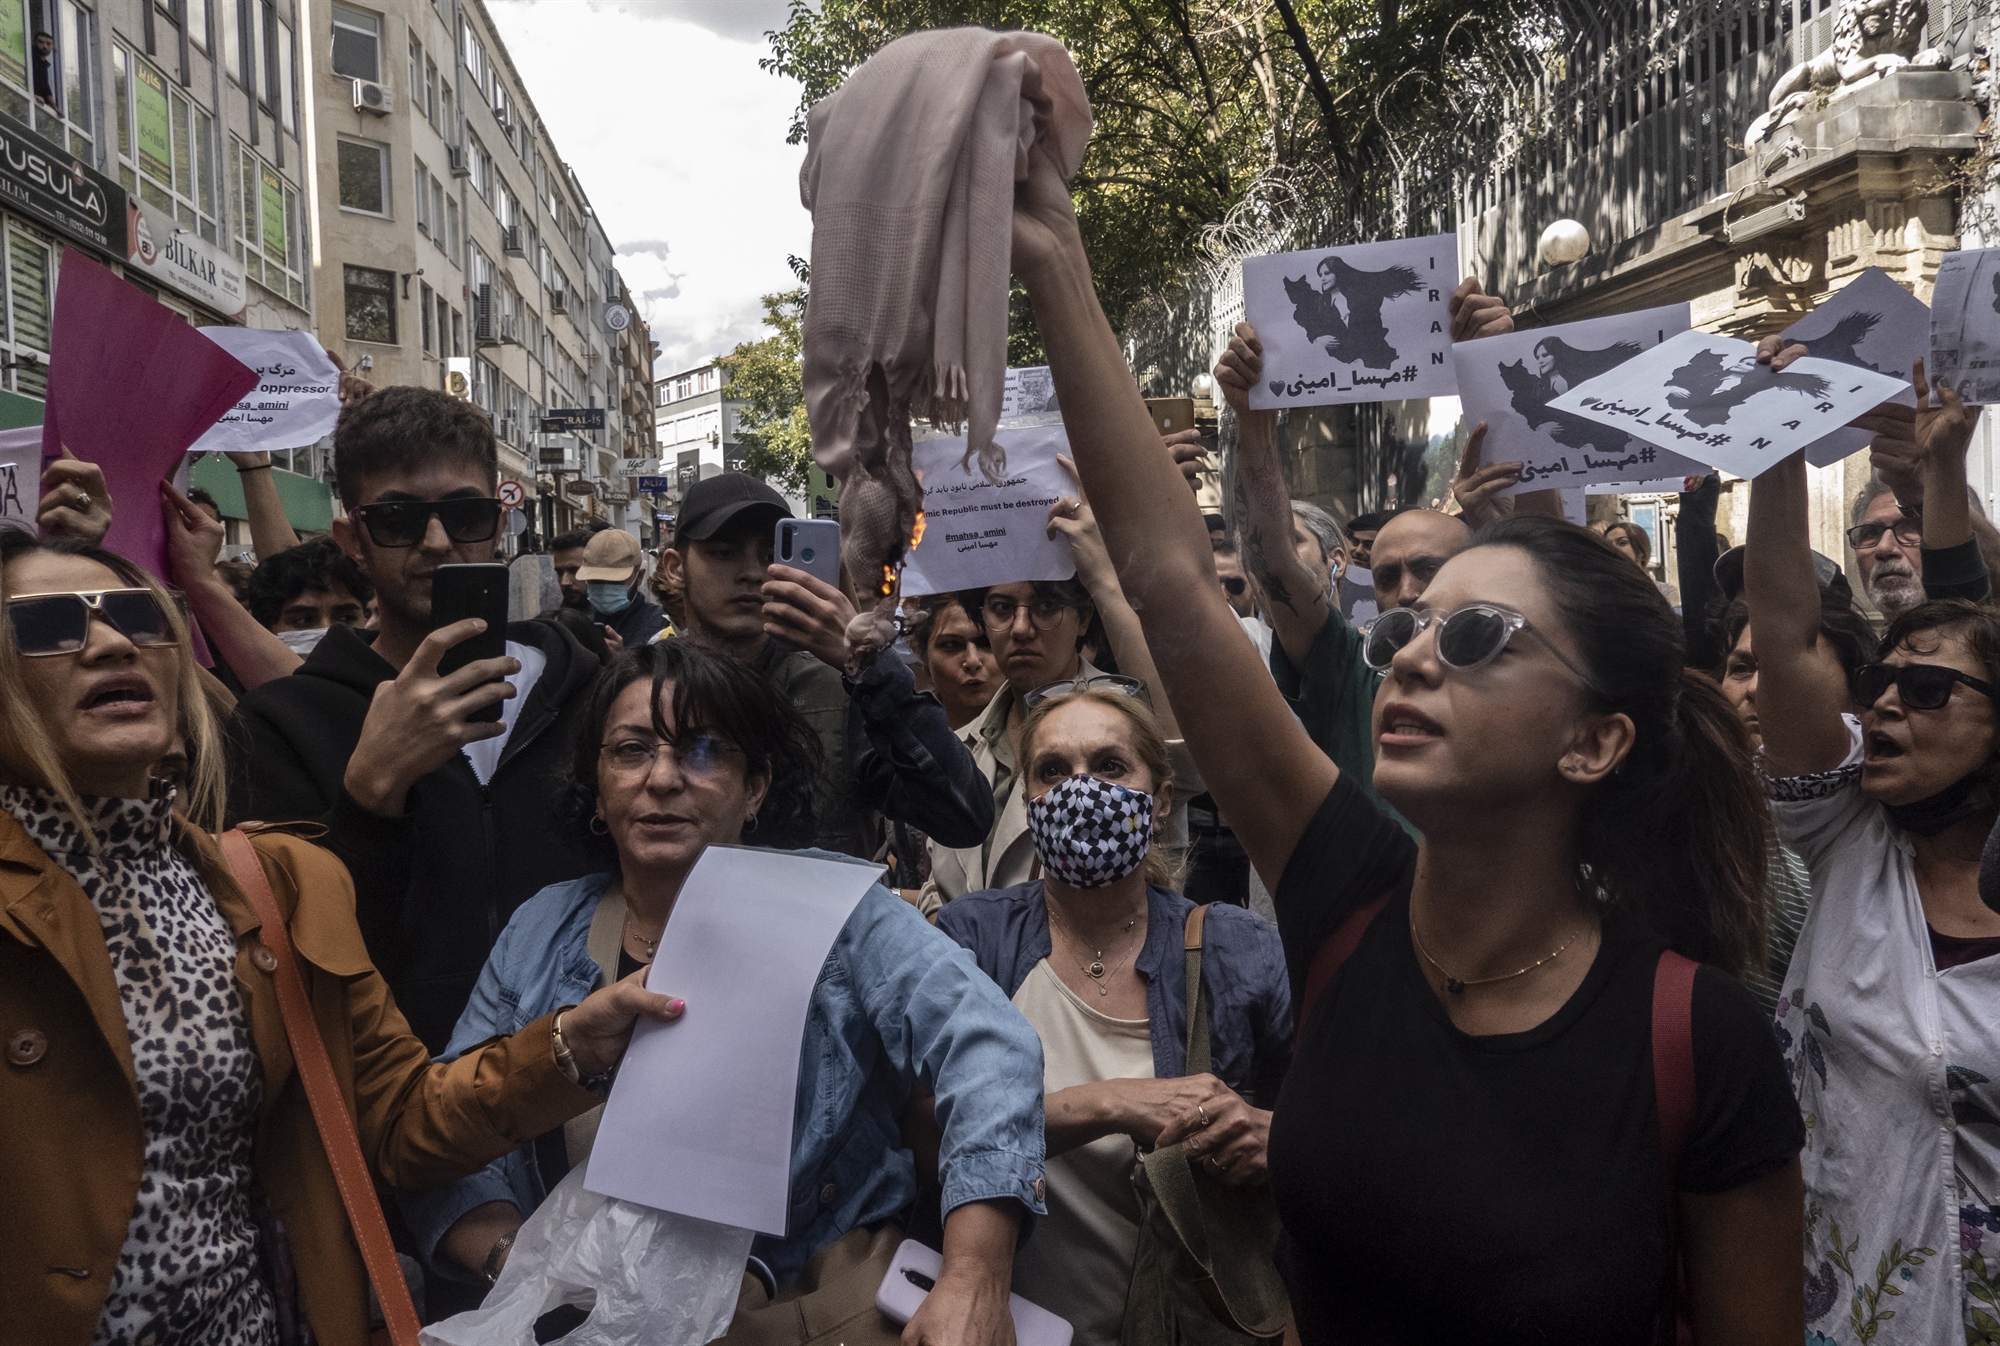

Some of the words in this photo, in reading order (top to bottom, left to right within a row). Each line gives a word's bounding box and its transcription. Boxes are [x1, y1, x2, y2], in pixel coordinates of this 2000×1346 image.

[0, 177, 29, 203] ILIM
[165, 233, 217, 287] BİLKAR
[268, 363, 296, 378] مرگ
[260, 384, 332, 395] oppressor
[232, 401, 289, 411] sa_amini
[216, 413, 245, 423] امینی
[247, 413, 274, 424] مهسا
[935, 484, 949, 494] باید
[950, 482, 967, 494] نابود
[942, 504, 979, 516] Republic
[981, 503, 1001, 512] must
[1003, 500, 1014, 509] be
[1016, 496, 1059, 508] destroyed
[945, 527, 1007, 542] #mahsa_amini
[957, 542, 977, 553] امینی
[978, 540, 998, 549] مهسا
